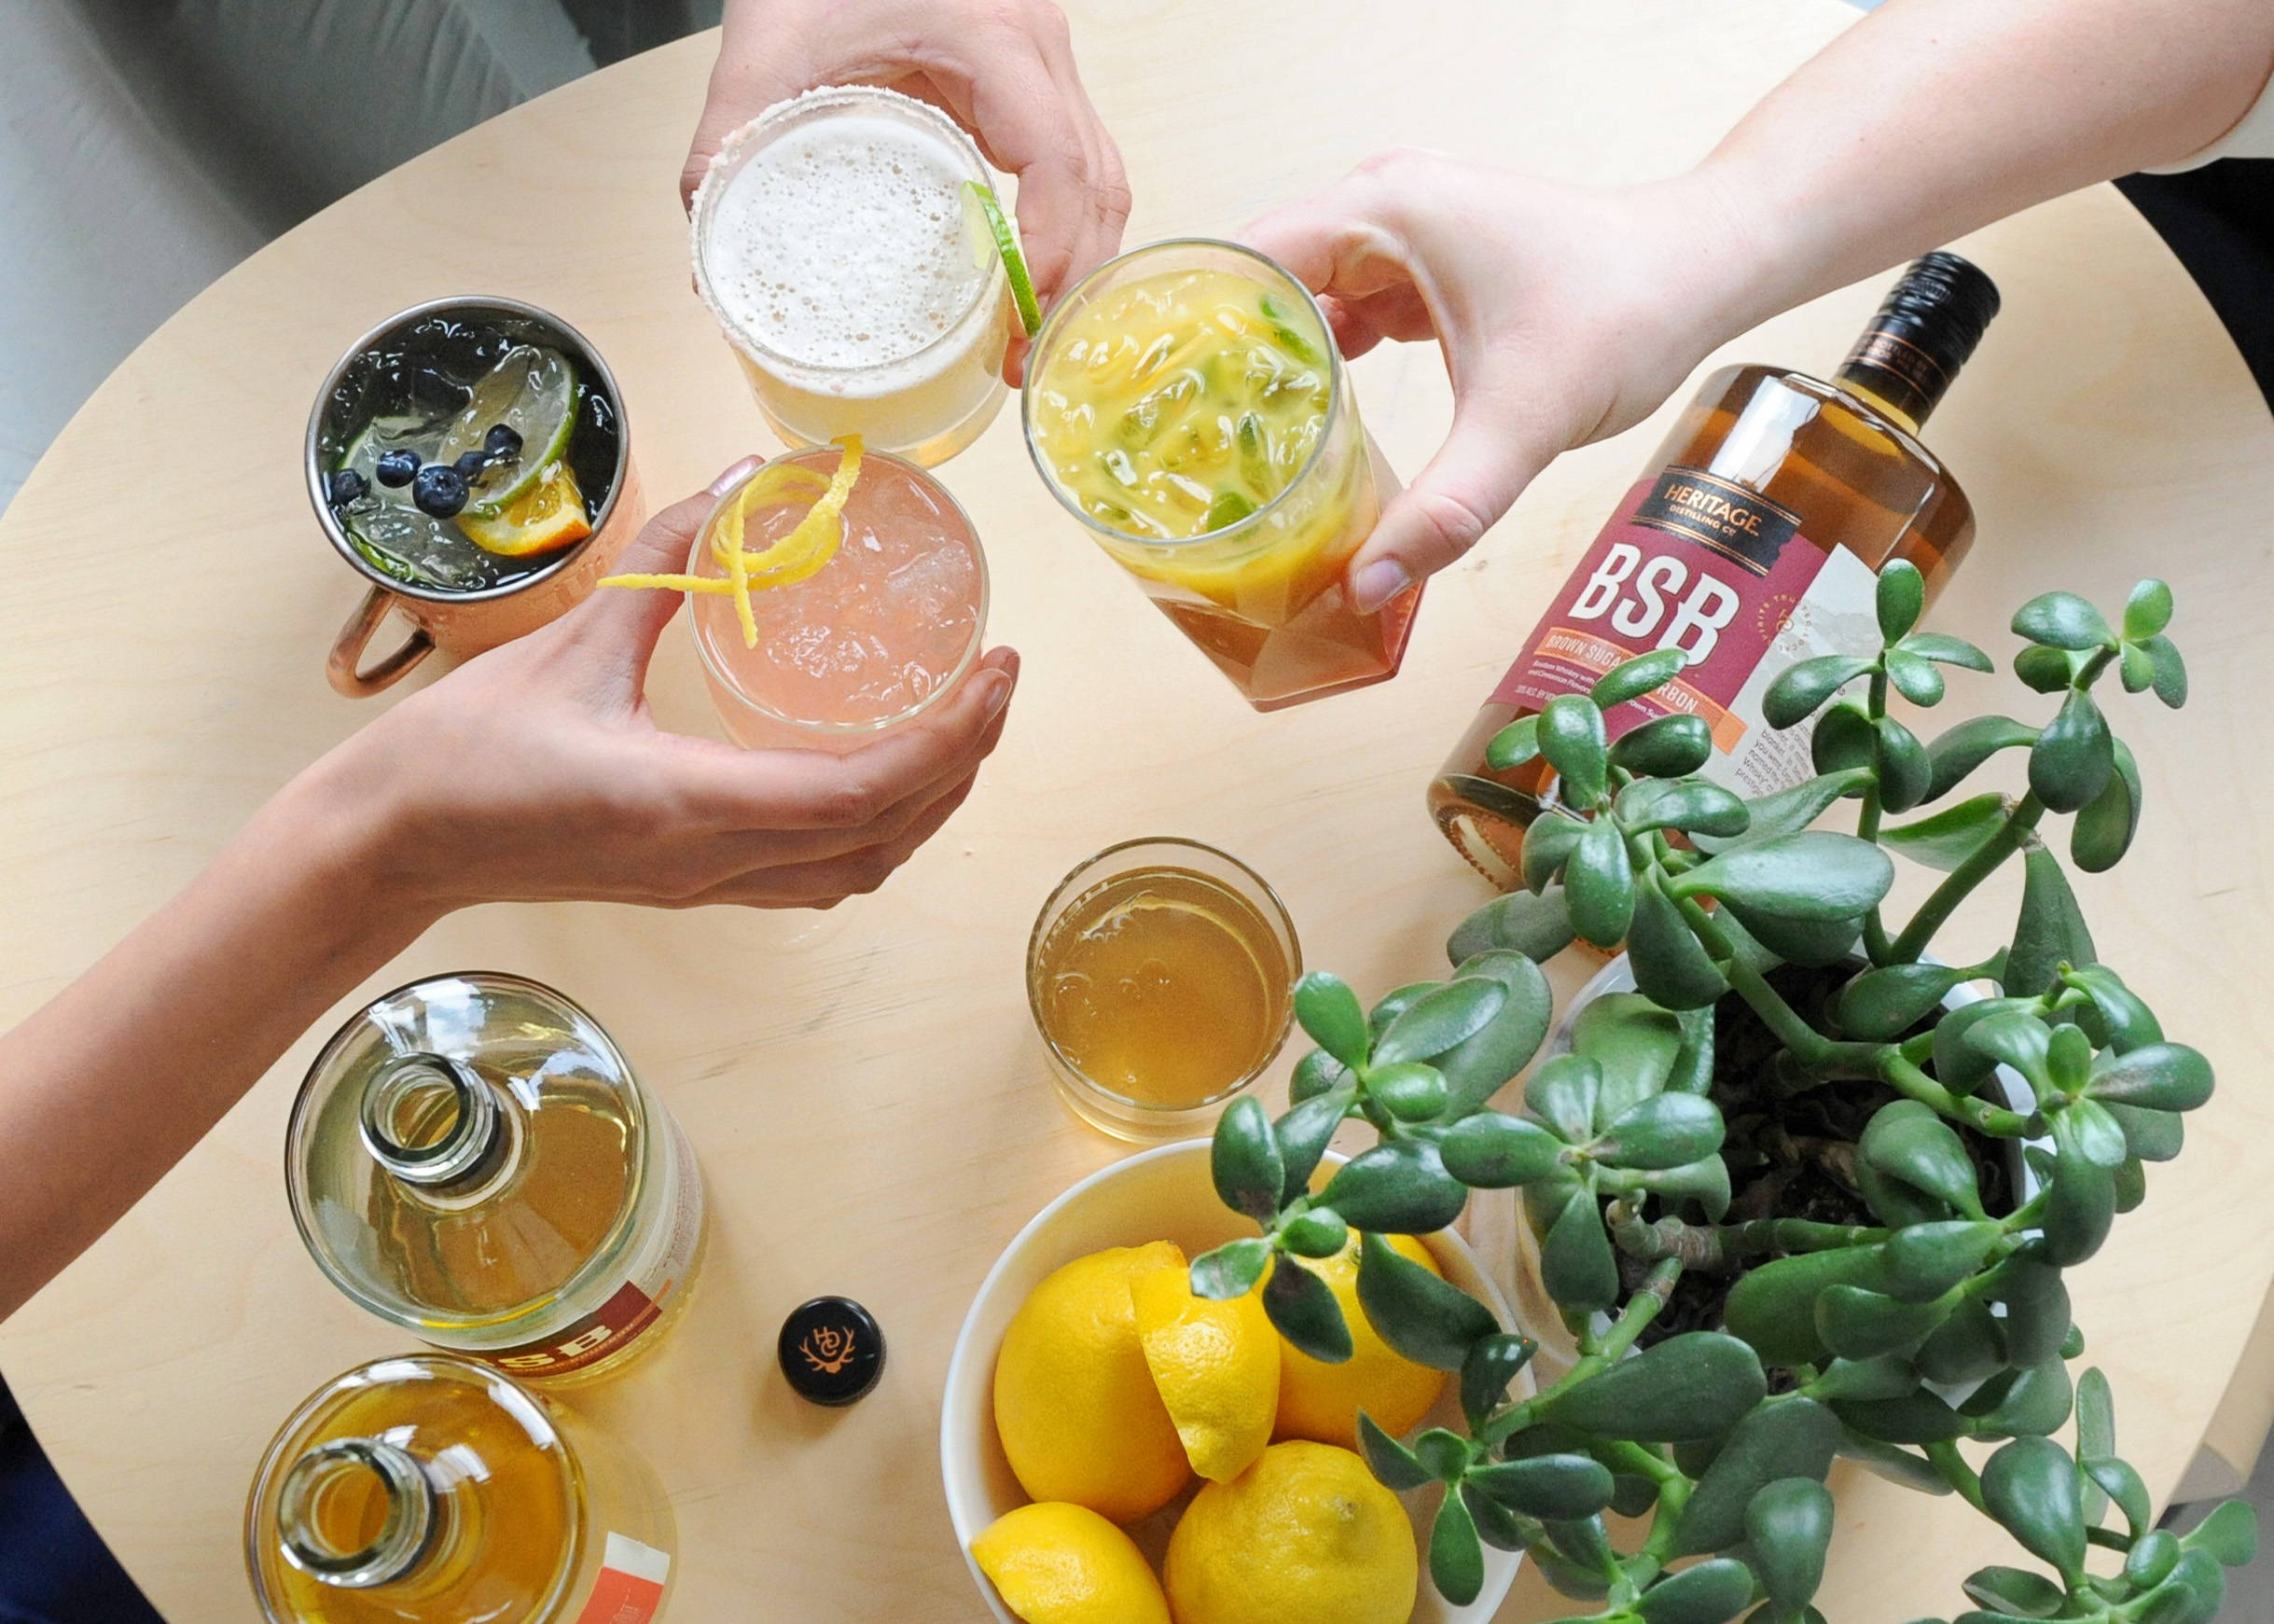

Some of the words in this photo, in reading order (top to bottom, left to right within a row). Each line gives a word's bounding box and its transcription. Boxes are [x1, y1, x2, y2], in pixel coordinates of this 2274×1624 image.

[1664, 484, 1762, 533] HERITAGE
[1669, 504, 1720, 529] DISTILLING
[1568, 543, 1740, 666] BSB
[1545, 635, 1588, 656] BROWN
[1587, 645, 1623, 669] SUGA
[1657, 682, 1699, 714] RBON
[1627, 699, 1647, 713] rown
[465, 1326, 612, 1367] SB
